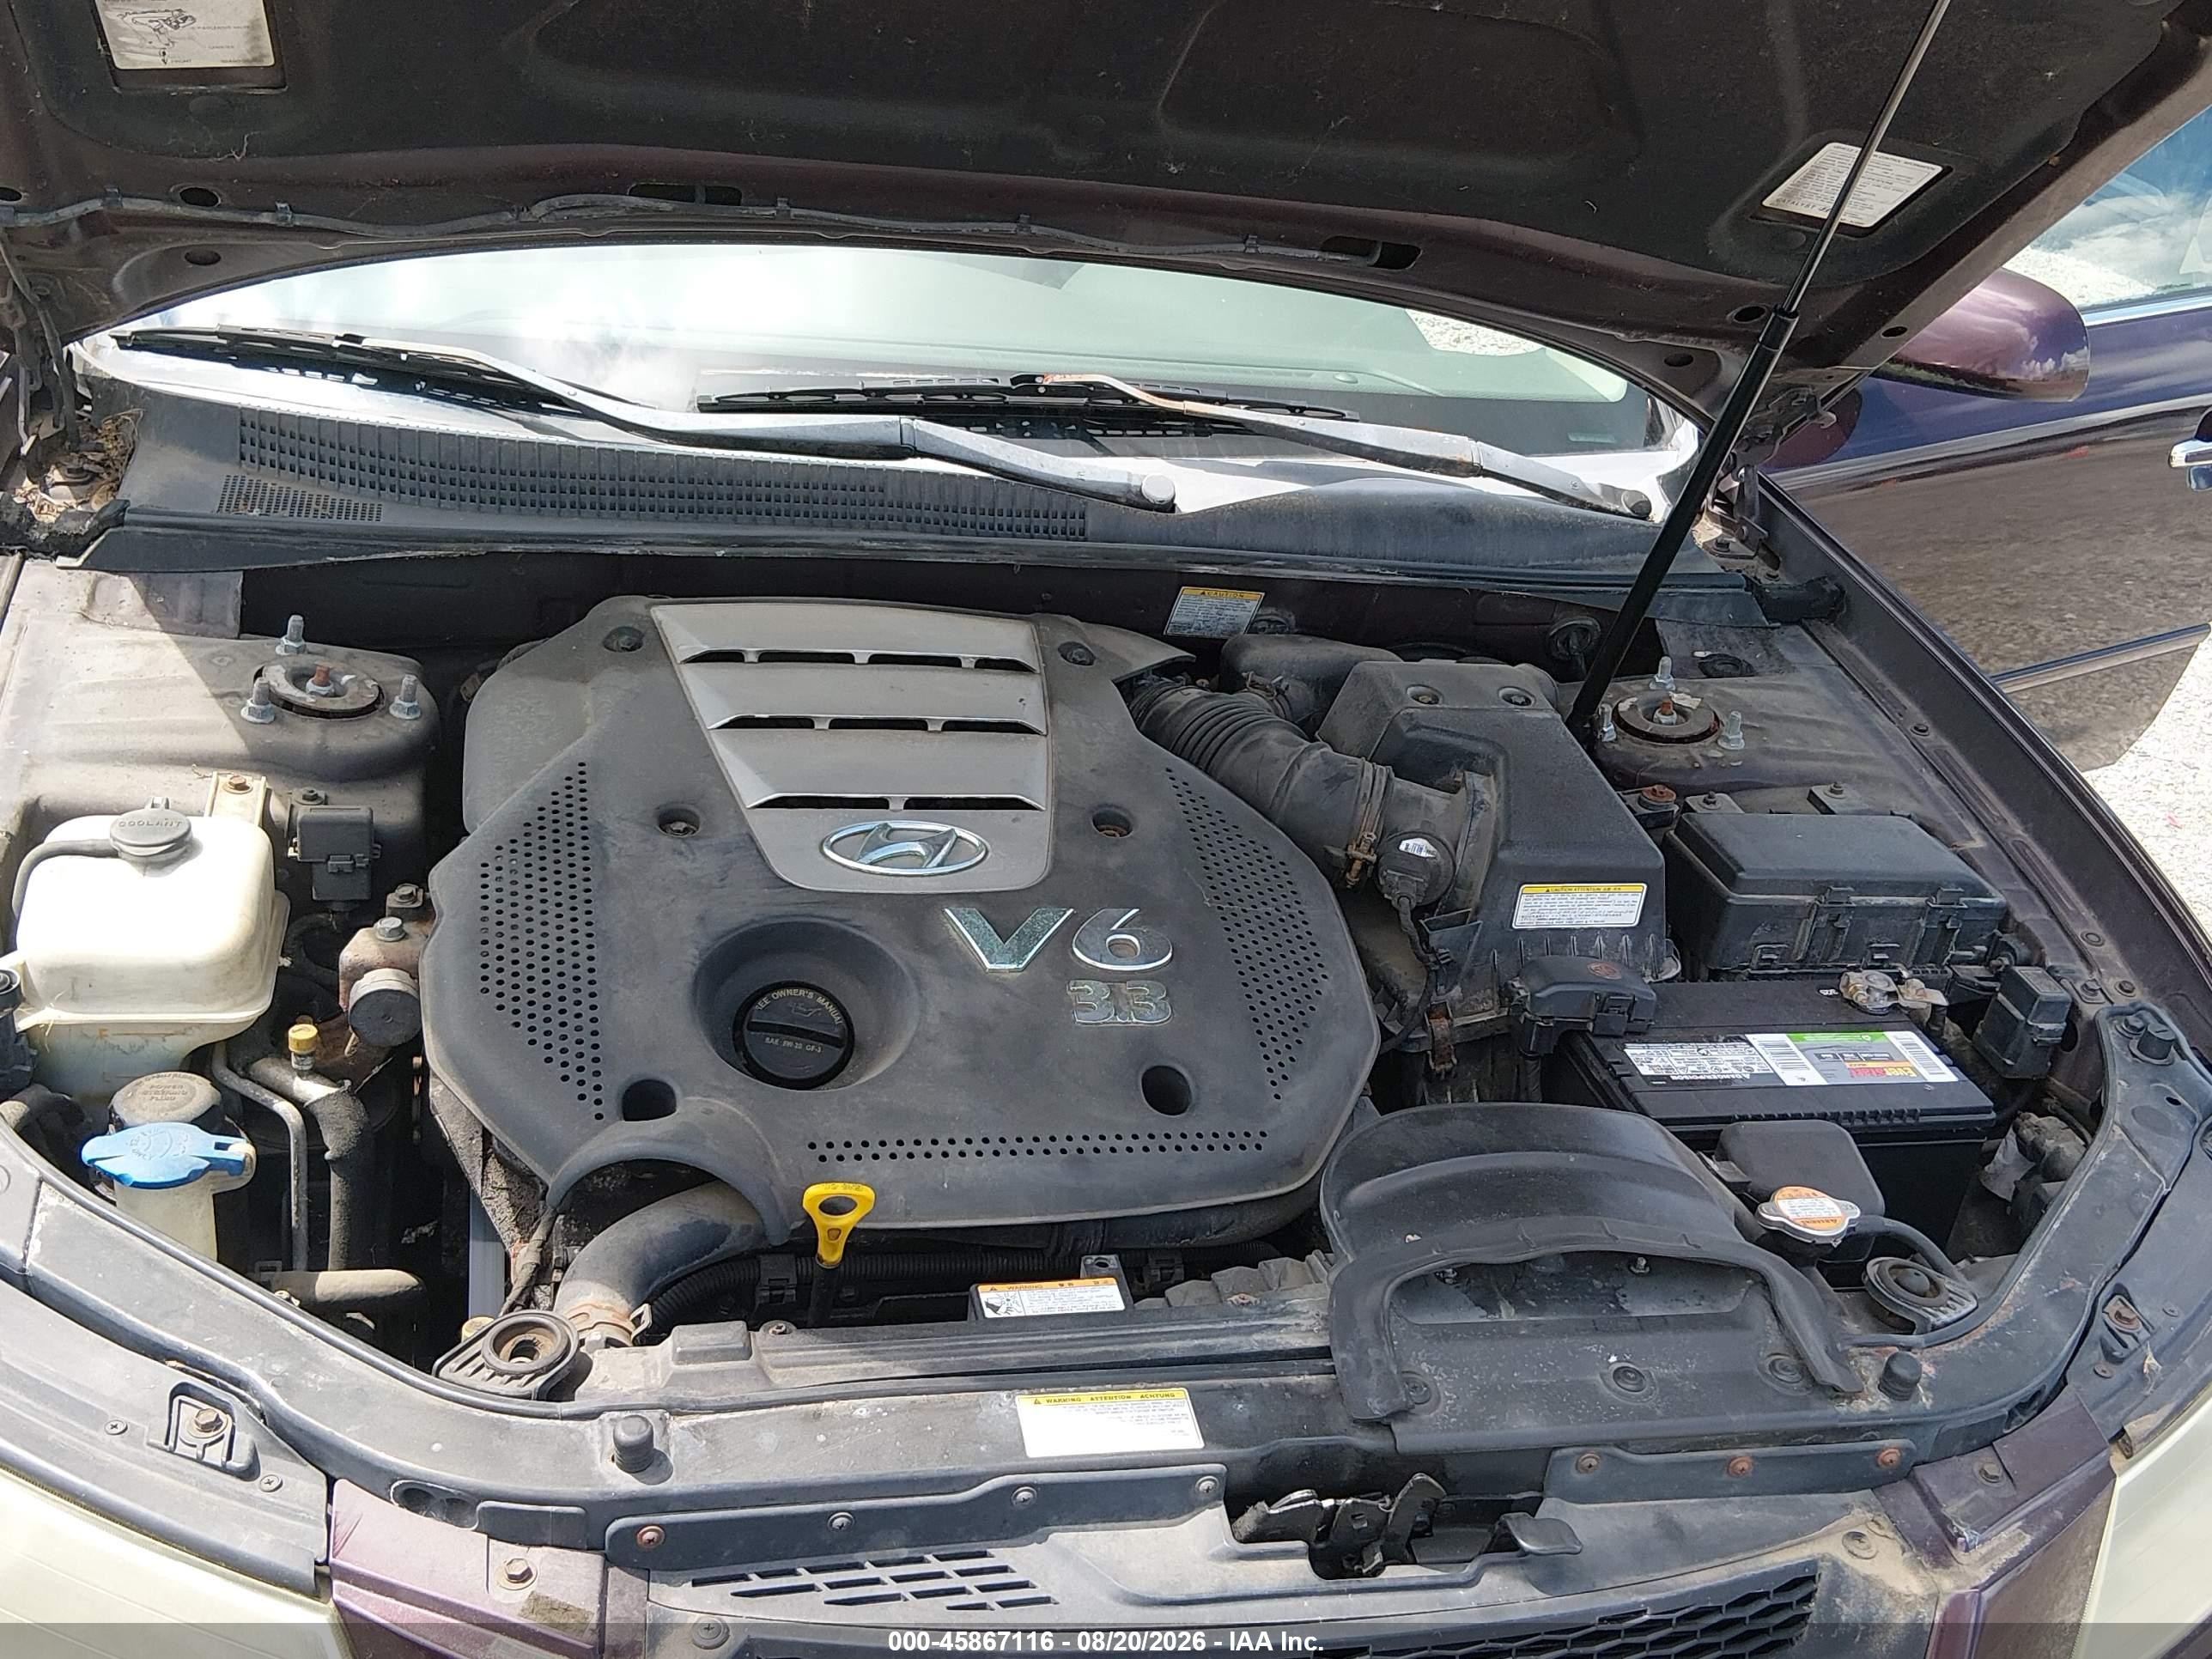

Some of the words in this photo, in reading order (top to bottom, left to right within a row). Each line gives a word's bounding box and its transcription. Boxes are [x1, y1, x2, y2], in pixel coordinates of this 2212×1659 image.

[118, 818, 182, 828] COOLANT
[944, 907, 1174, 973] V6
[771, 988, 814, 1000] OWNER'S
